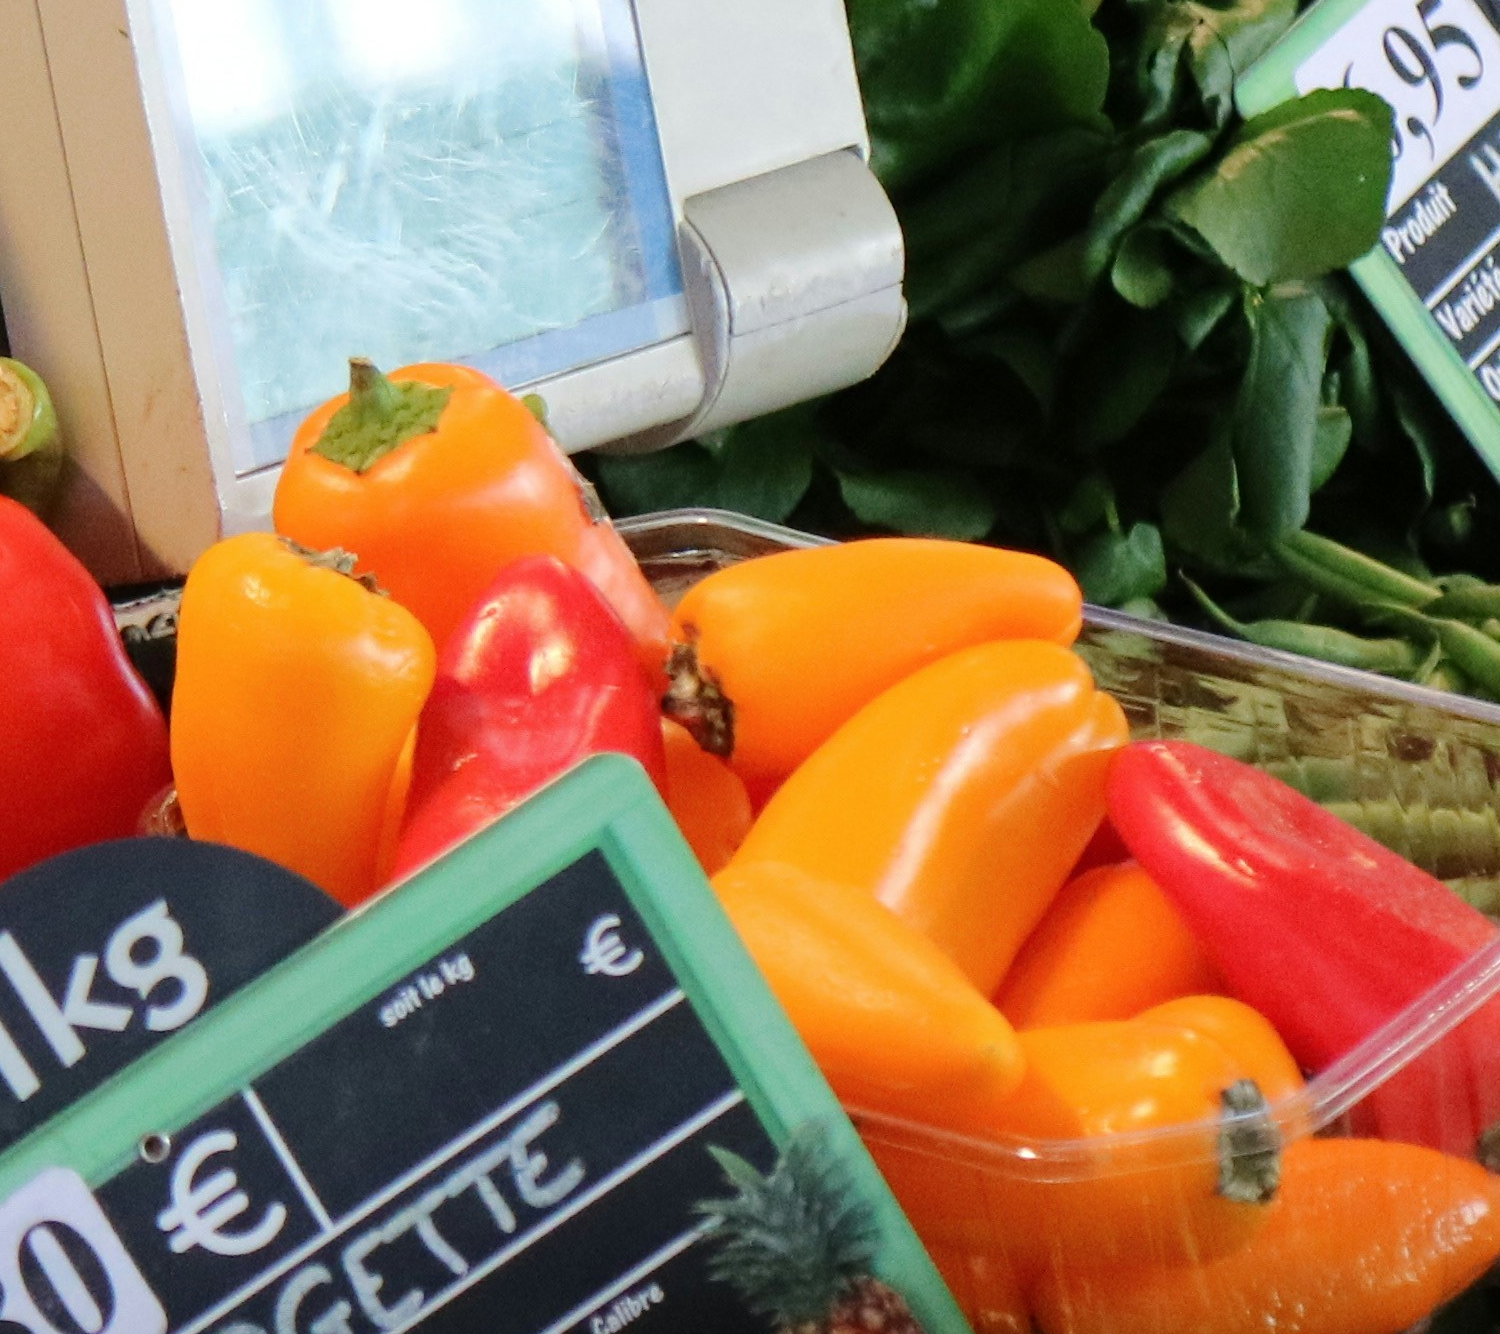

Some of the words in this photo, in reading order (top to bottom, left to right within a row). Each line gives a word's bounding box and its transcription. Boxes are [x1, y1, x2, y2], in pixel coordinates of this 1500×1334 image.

[1380, 179, 1458, 265] Produit
[417, 973, 445, 1000] le
[438, 952, 476, 986] kg
[578, 912, 646, 978] €
[155, 1127, 288, 1257] €
